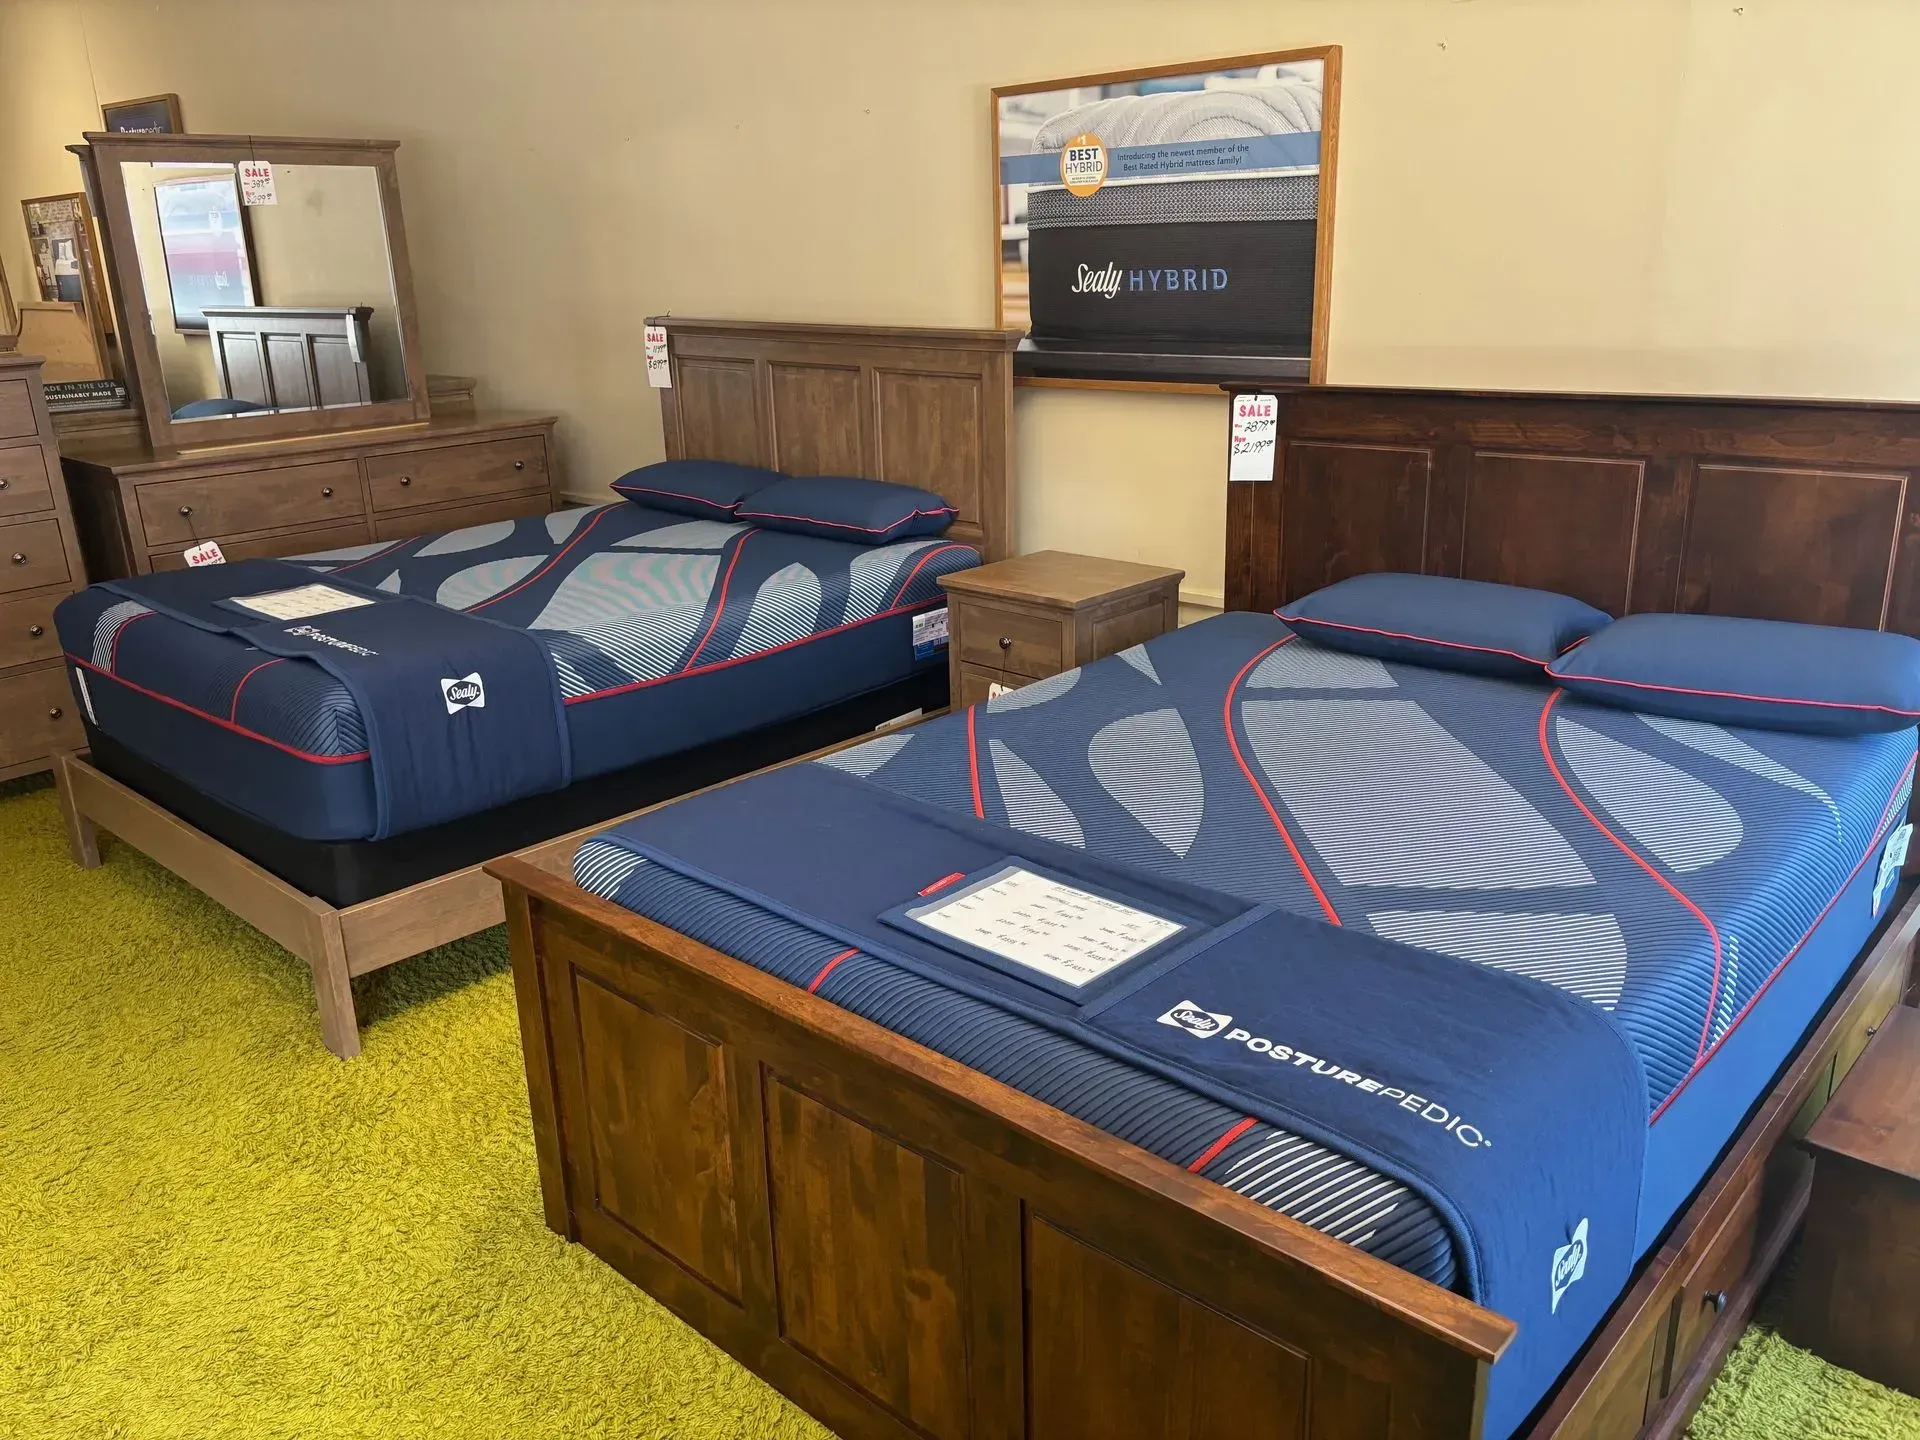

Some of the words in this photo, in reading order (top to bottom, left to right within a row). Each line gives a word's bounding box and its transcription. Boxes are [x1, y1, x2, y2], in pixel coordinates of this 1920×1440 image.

[1069, 148, 1099, 161] BEST
[1117, 152, 1156, 161] Introducing
[1157, 150, 1169, 158] the
[1170, 149, 1194, 157] newest
[1196, 146, 1225, 155] member
[1227, 144, 1236, 153] of
[1237, 144, 1250, 152] the
[1065, 160, 1103, 174] HYBRID
[1123, 163, 1138, 171] Best
[1139, 161, 1159, 170] Rated
[1160, 160, 1184, 171] Hybrid
[1185, 157, 1216, 167] mattress
[1217, 156, 1242, 166] family!
[245, 168, 270, 177] SALE
[1071, 261, 1123, 299] Sealy
[1129, 268, 1228, 292] HYBRID
[647, 333, 664, 342] SALE
[45, 392, 90, 400] SUSTAINABLY
[1239, 404, 1271, 417] SALE
[1234, 435, 1247, 443] Now
[192, 548, 219, 564] SALE
[449, 683, 480, 701] Sealy
[1174, 1009, 1216, 1031] Sealy
[1223, 1027, 1488, 1148] POSTUREPEDIC
